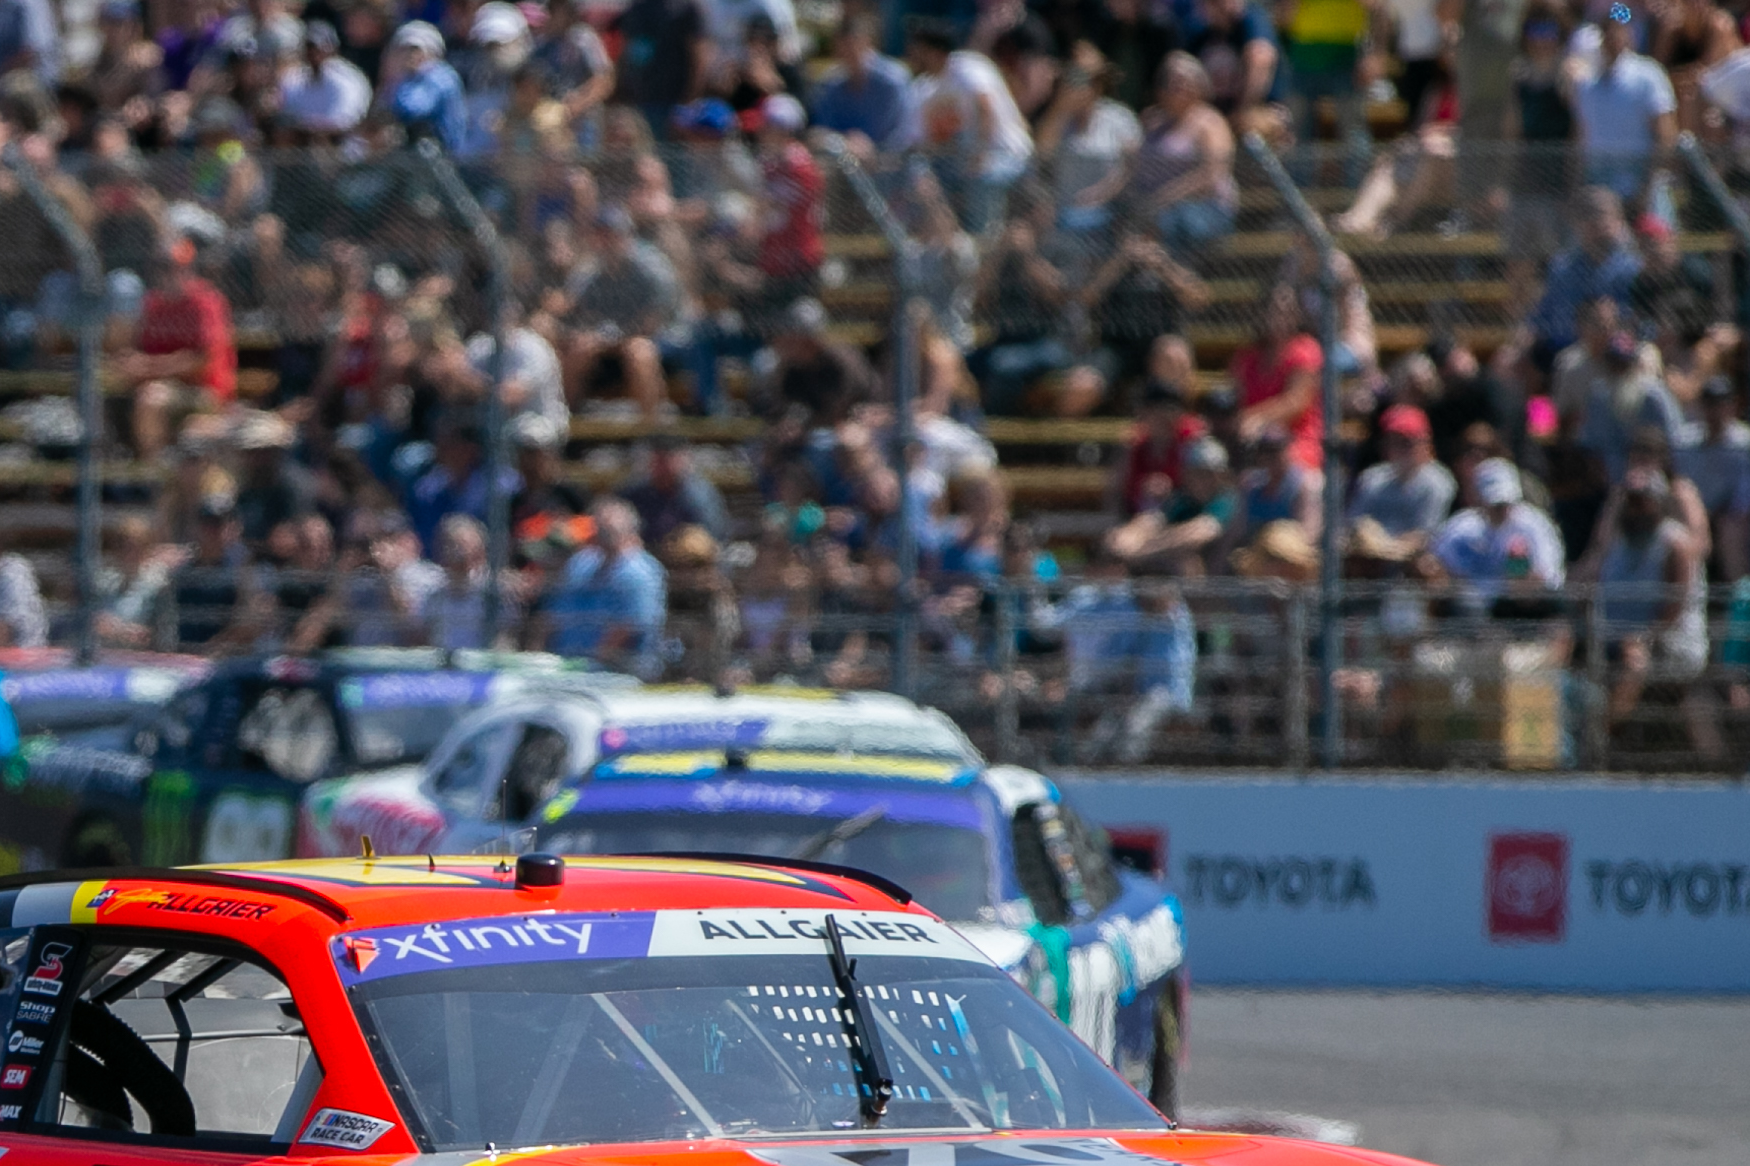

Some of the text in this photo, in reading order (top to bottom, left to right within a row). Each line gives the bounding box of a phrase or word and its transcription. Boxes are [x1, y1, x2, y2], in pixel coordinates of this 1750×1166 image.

[1184, 853, 1377, 908] TOYOTA
[1584, 859, 1750, 918] TOYOT
[379, 917, 596, 963] xfinity
[700, 919, 940, 944] ALLGAIER
[4, 1069, 27, 1085] SEM
[310, 1127, 365, 1144] RACE CAR
[333, 1114, 379, 1133] NASCAR
